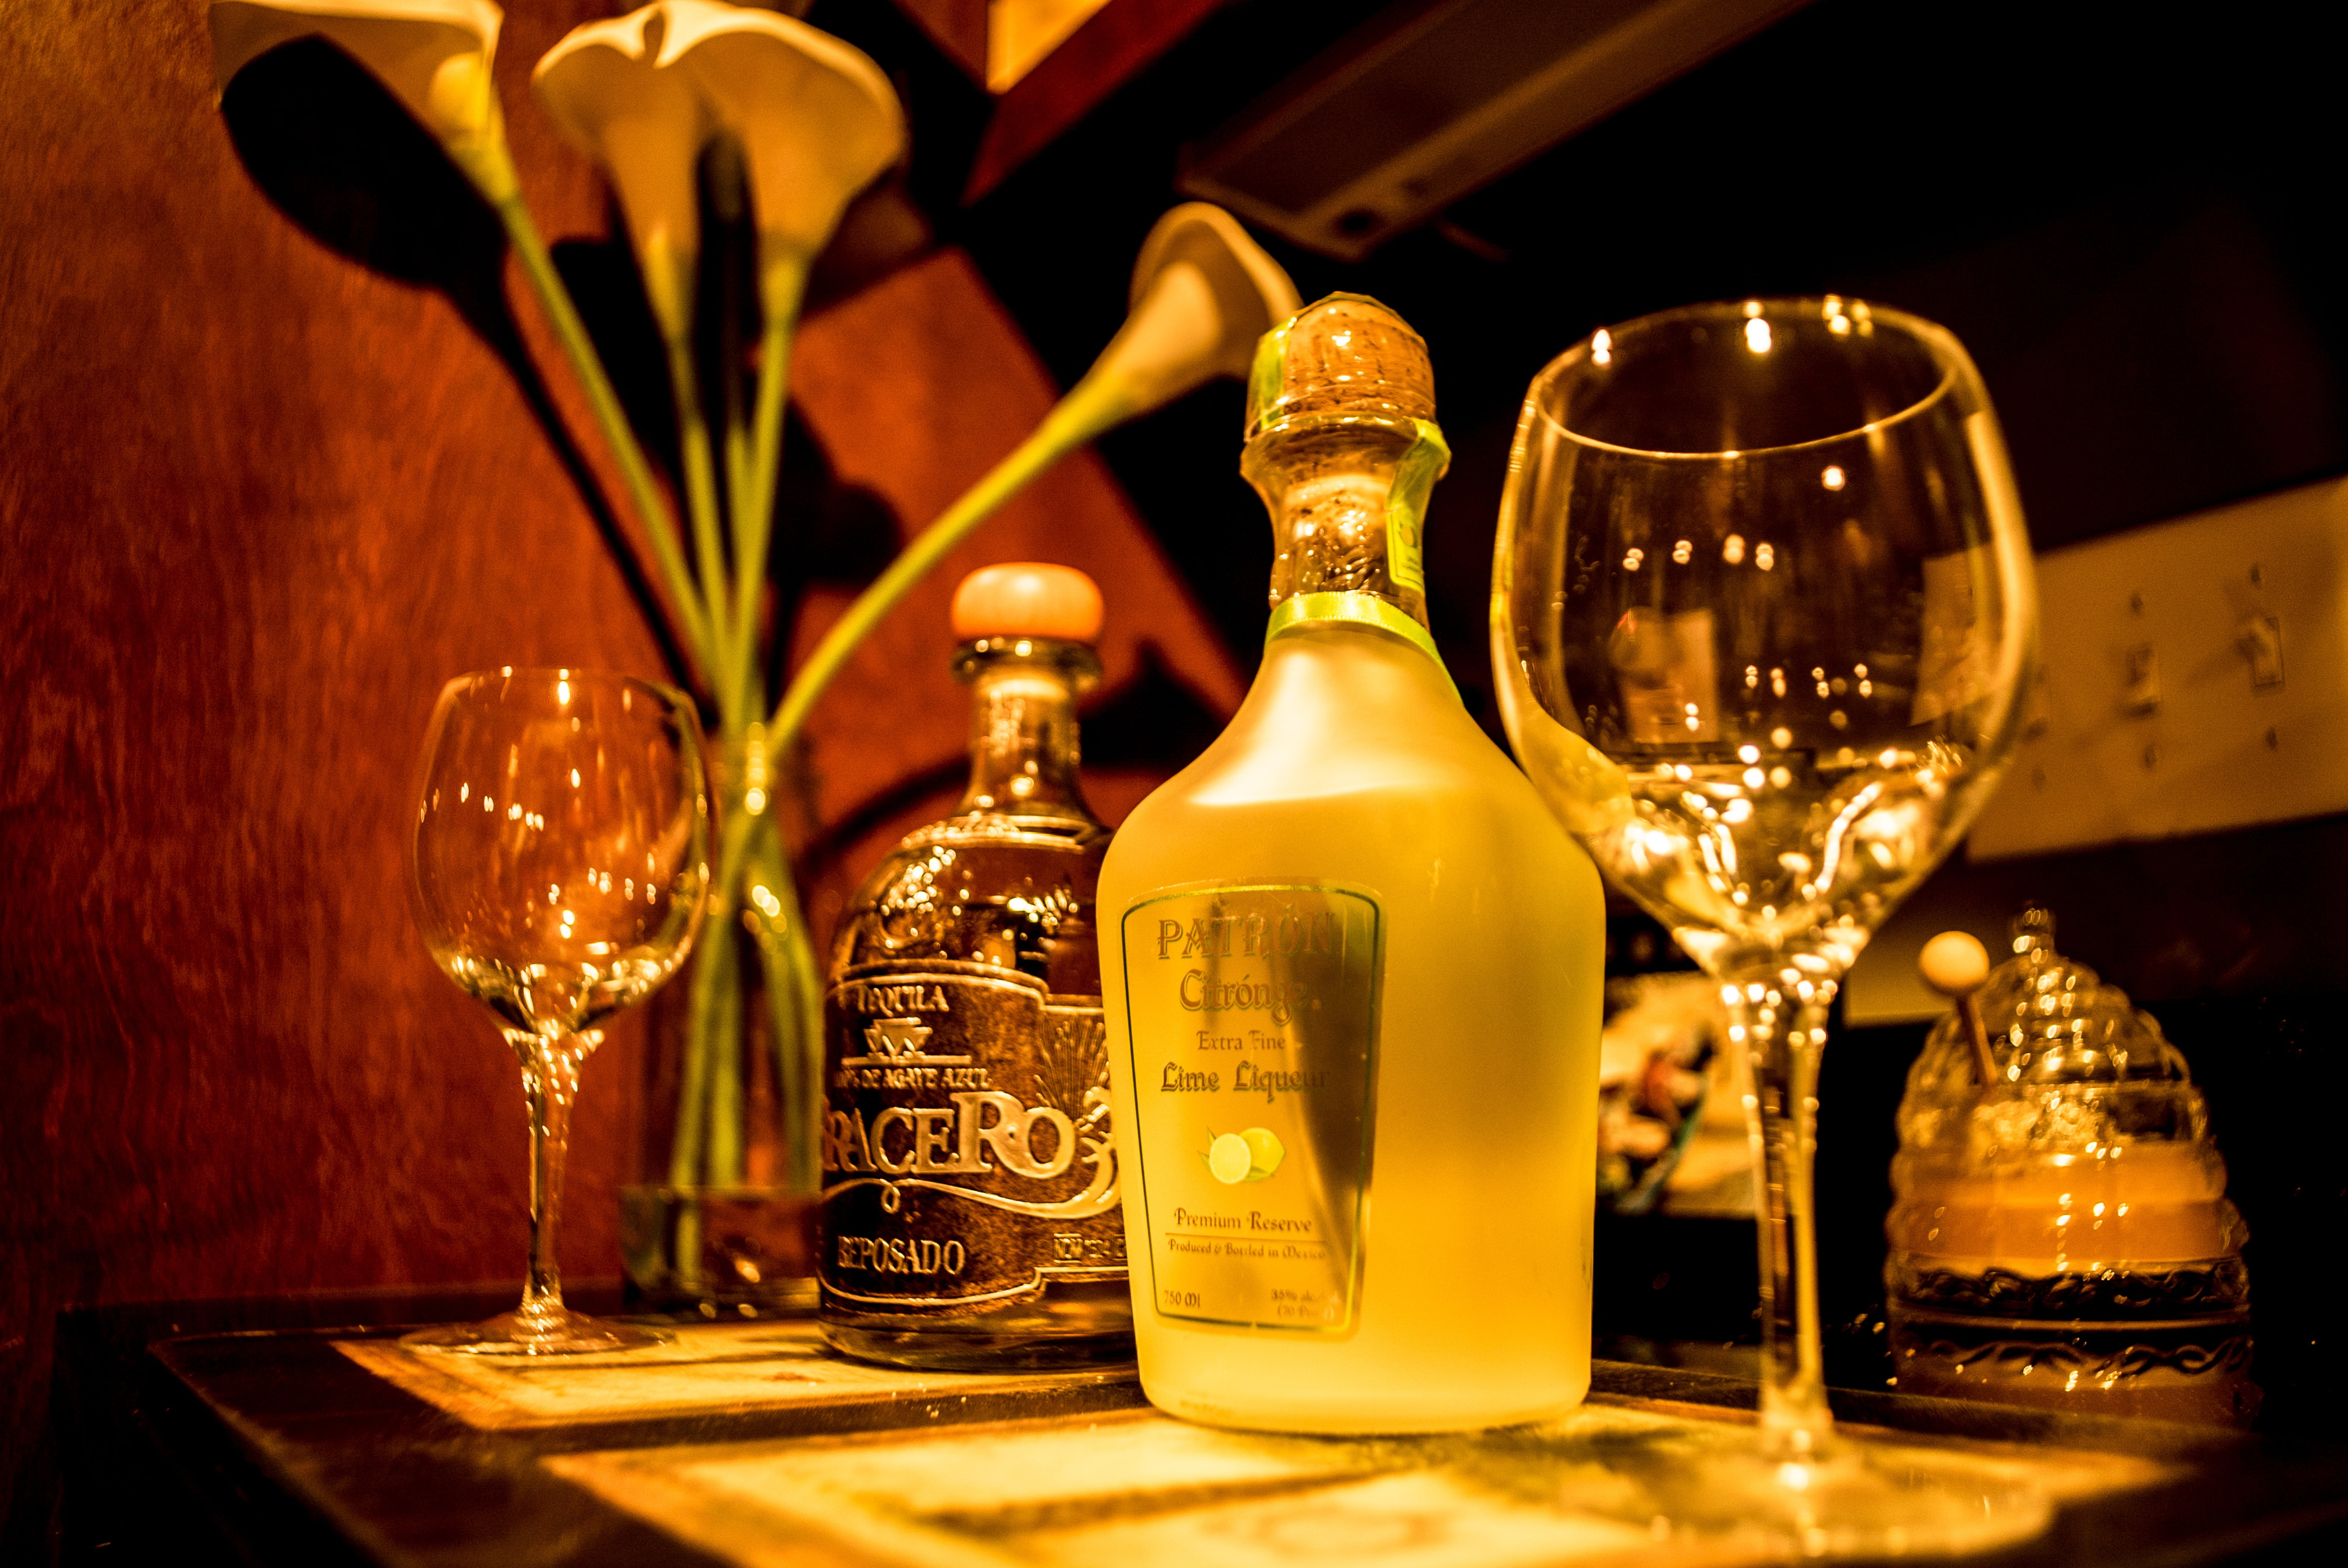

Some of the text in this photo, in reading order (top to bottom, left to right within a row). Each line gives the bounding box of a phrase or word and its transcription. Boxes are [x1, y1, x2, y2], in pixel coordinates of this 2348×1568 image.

[1196, 1029, 1286, 1051] Extra Fine
[942, 1068, 993, 1090] AZUL
[1161, 1059, 1331, 1104] Lime Liqueur
[823, 1091, 1075, 1178] RACERO
[1174, 1207, 1312, 1232] Premium Reserve
[1168, 1238, 1211, 1253] Produced
[1224, 1242, 1264, 1256] Bottled
[1268, 1247, 1279, 1258] in
[1164, 1290, 1181, 1306] 750
